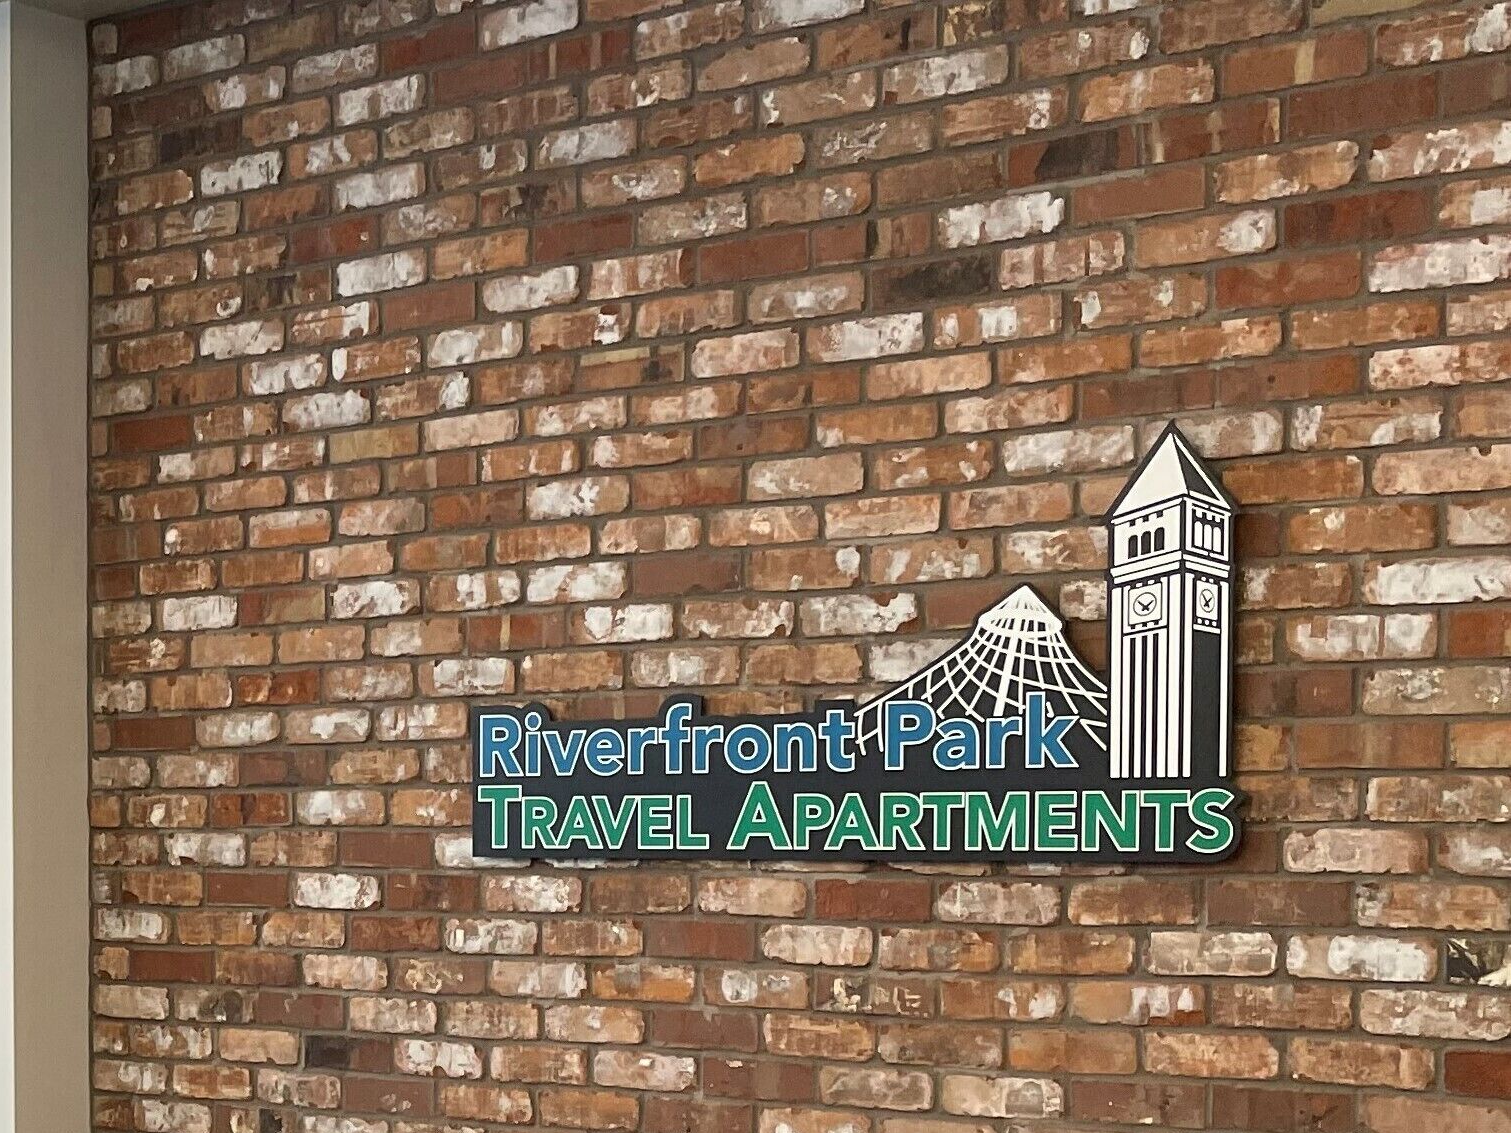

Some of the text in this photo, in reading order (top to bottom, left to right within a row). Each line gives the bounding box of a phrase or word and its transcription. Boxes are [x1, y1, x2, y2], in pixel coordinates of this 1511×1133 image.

[478, 691, 1080, 777] Riverfront Park
[477, 781, 1235, 853] TRAVEL APARTMENTS
